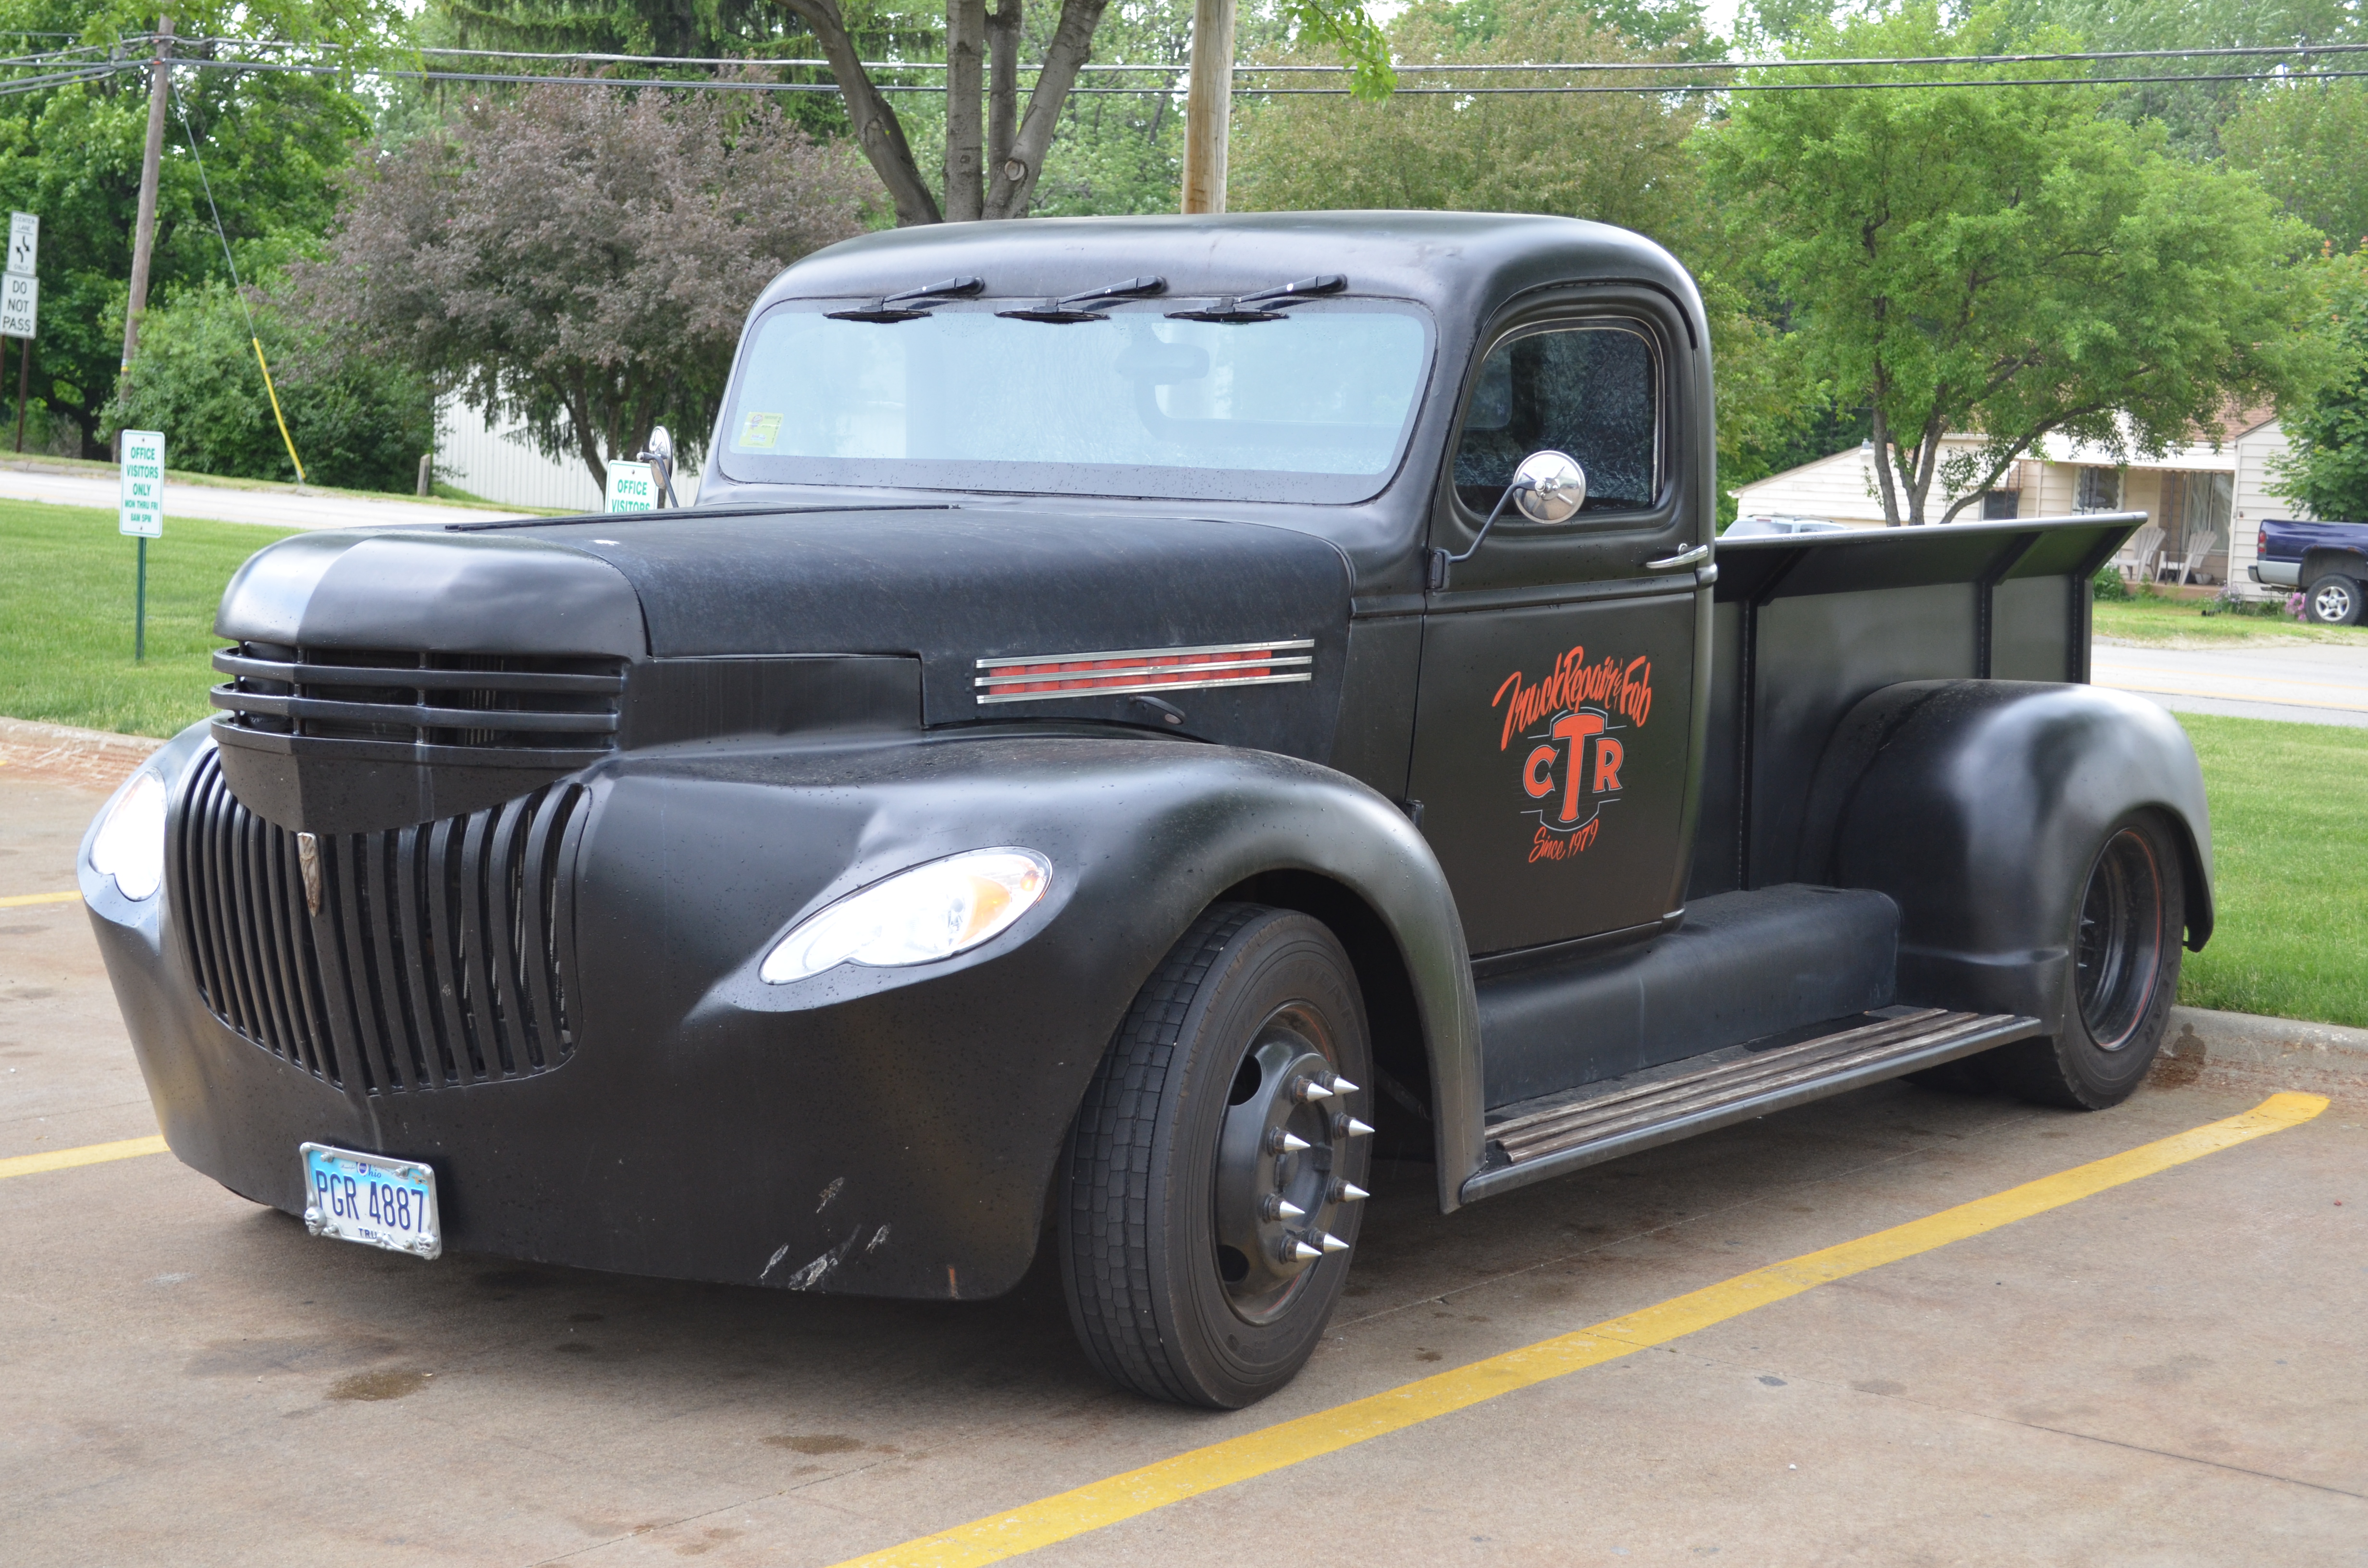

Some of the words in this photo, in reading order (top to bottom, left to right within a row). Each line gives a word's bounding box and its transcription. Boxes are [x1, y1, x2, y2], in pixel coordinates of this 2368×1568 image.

[14, 215, 35, 224] CENTER
[12, 280, 27, 294] DO
[7, 297, 29, 313] NOT
[2, 316, 31, 331] PASS
[131, 447, 155, 460] OFFICE
[126, 465, 159, 478] VISITORS
[133, 483, 151, 496] ONLY
[617, 479, 647, 496] OFFICE
[125, 499, 135, 507] MON
[137, 501, 149, 509] THRU
[142, 514, 151, 522] 5PM
[1492, 653, 1565, 751] Truck
[1564, 646, 1618, 713] Repair
[1620, 655, 1652, 727] Fab
[1529, 826, 1565, 863] Since
[1567, 819, 1599, 859] 1979
[315, 1170, 359, 1220] PGR
[369, 1180, 423, 1233] 4887
